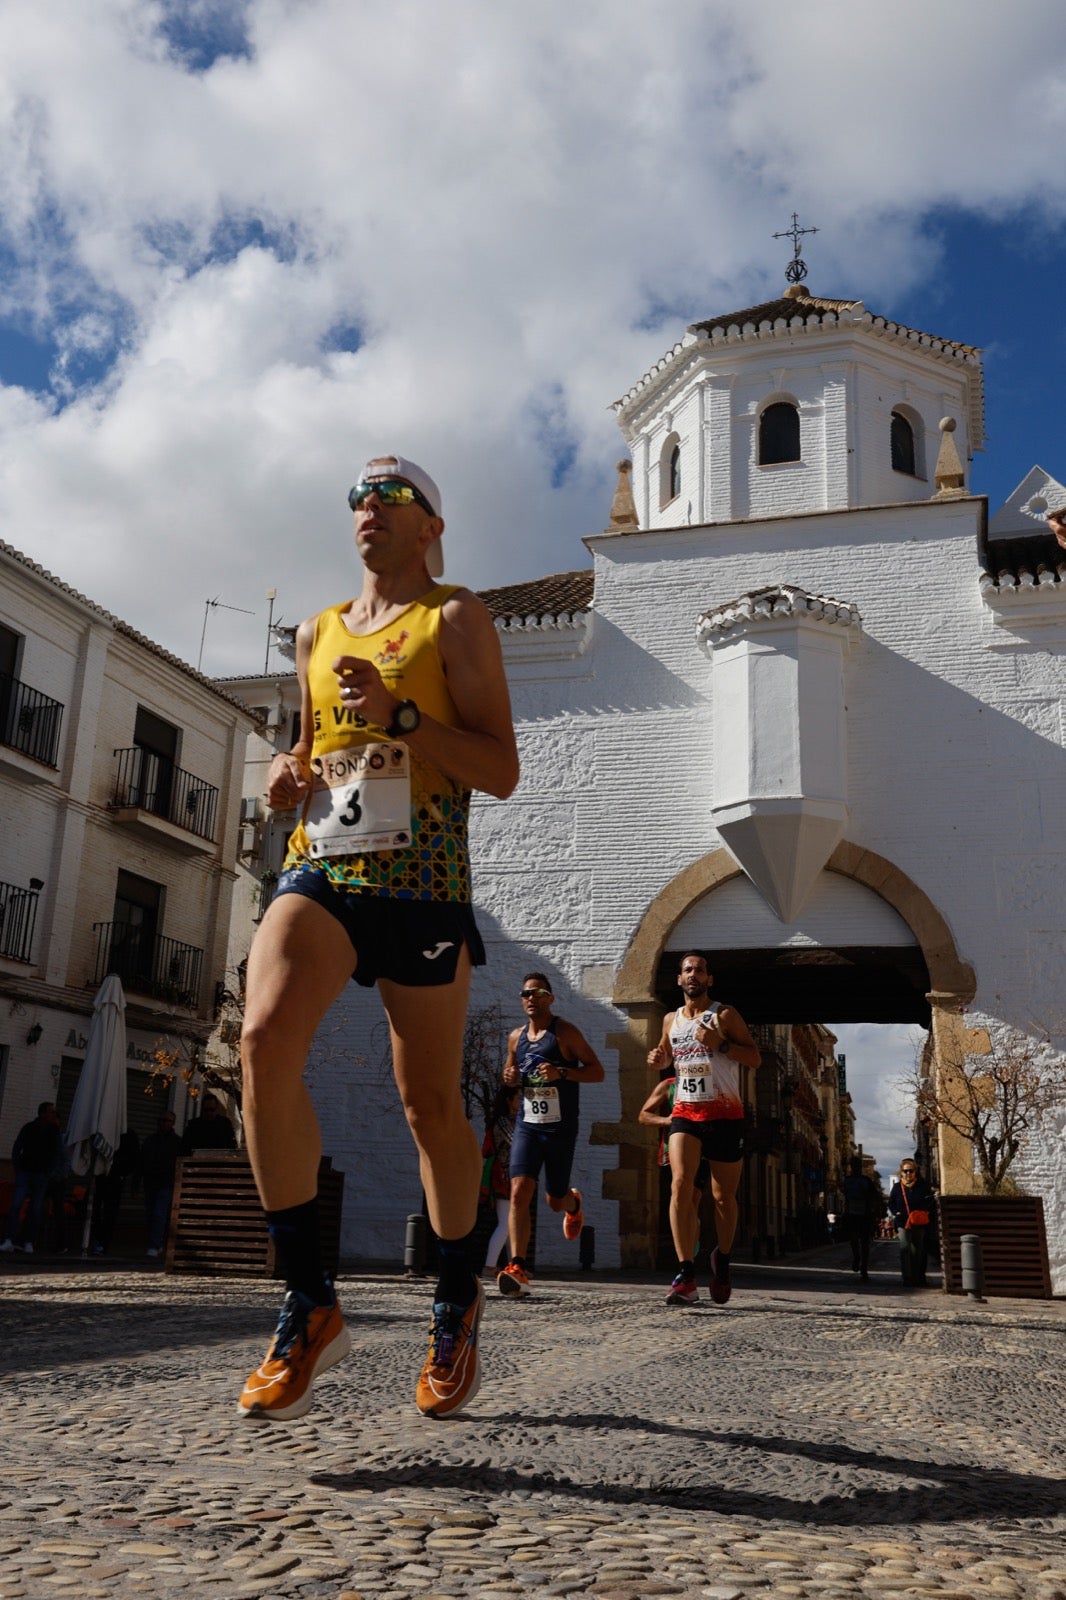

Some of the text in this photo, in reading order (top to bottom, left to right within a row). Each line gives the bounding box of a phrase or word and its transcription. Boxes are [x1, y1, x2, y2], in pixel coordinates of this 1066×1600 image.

[328, 753, 385, 779] FONDO
[339, 788, 363, 827] 3
[682, 1077, 706, 1094] 451
[531, 1100, 549, 1115] 89
